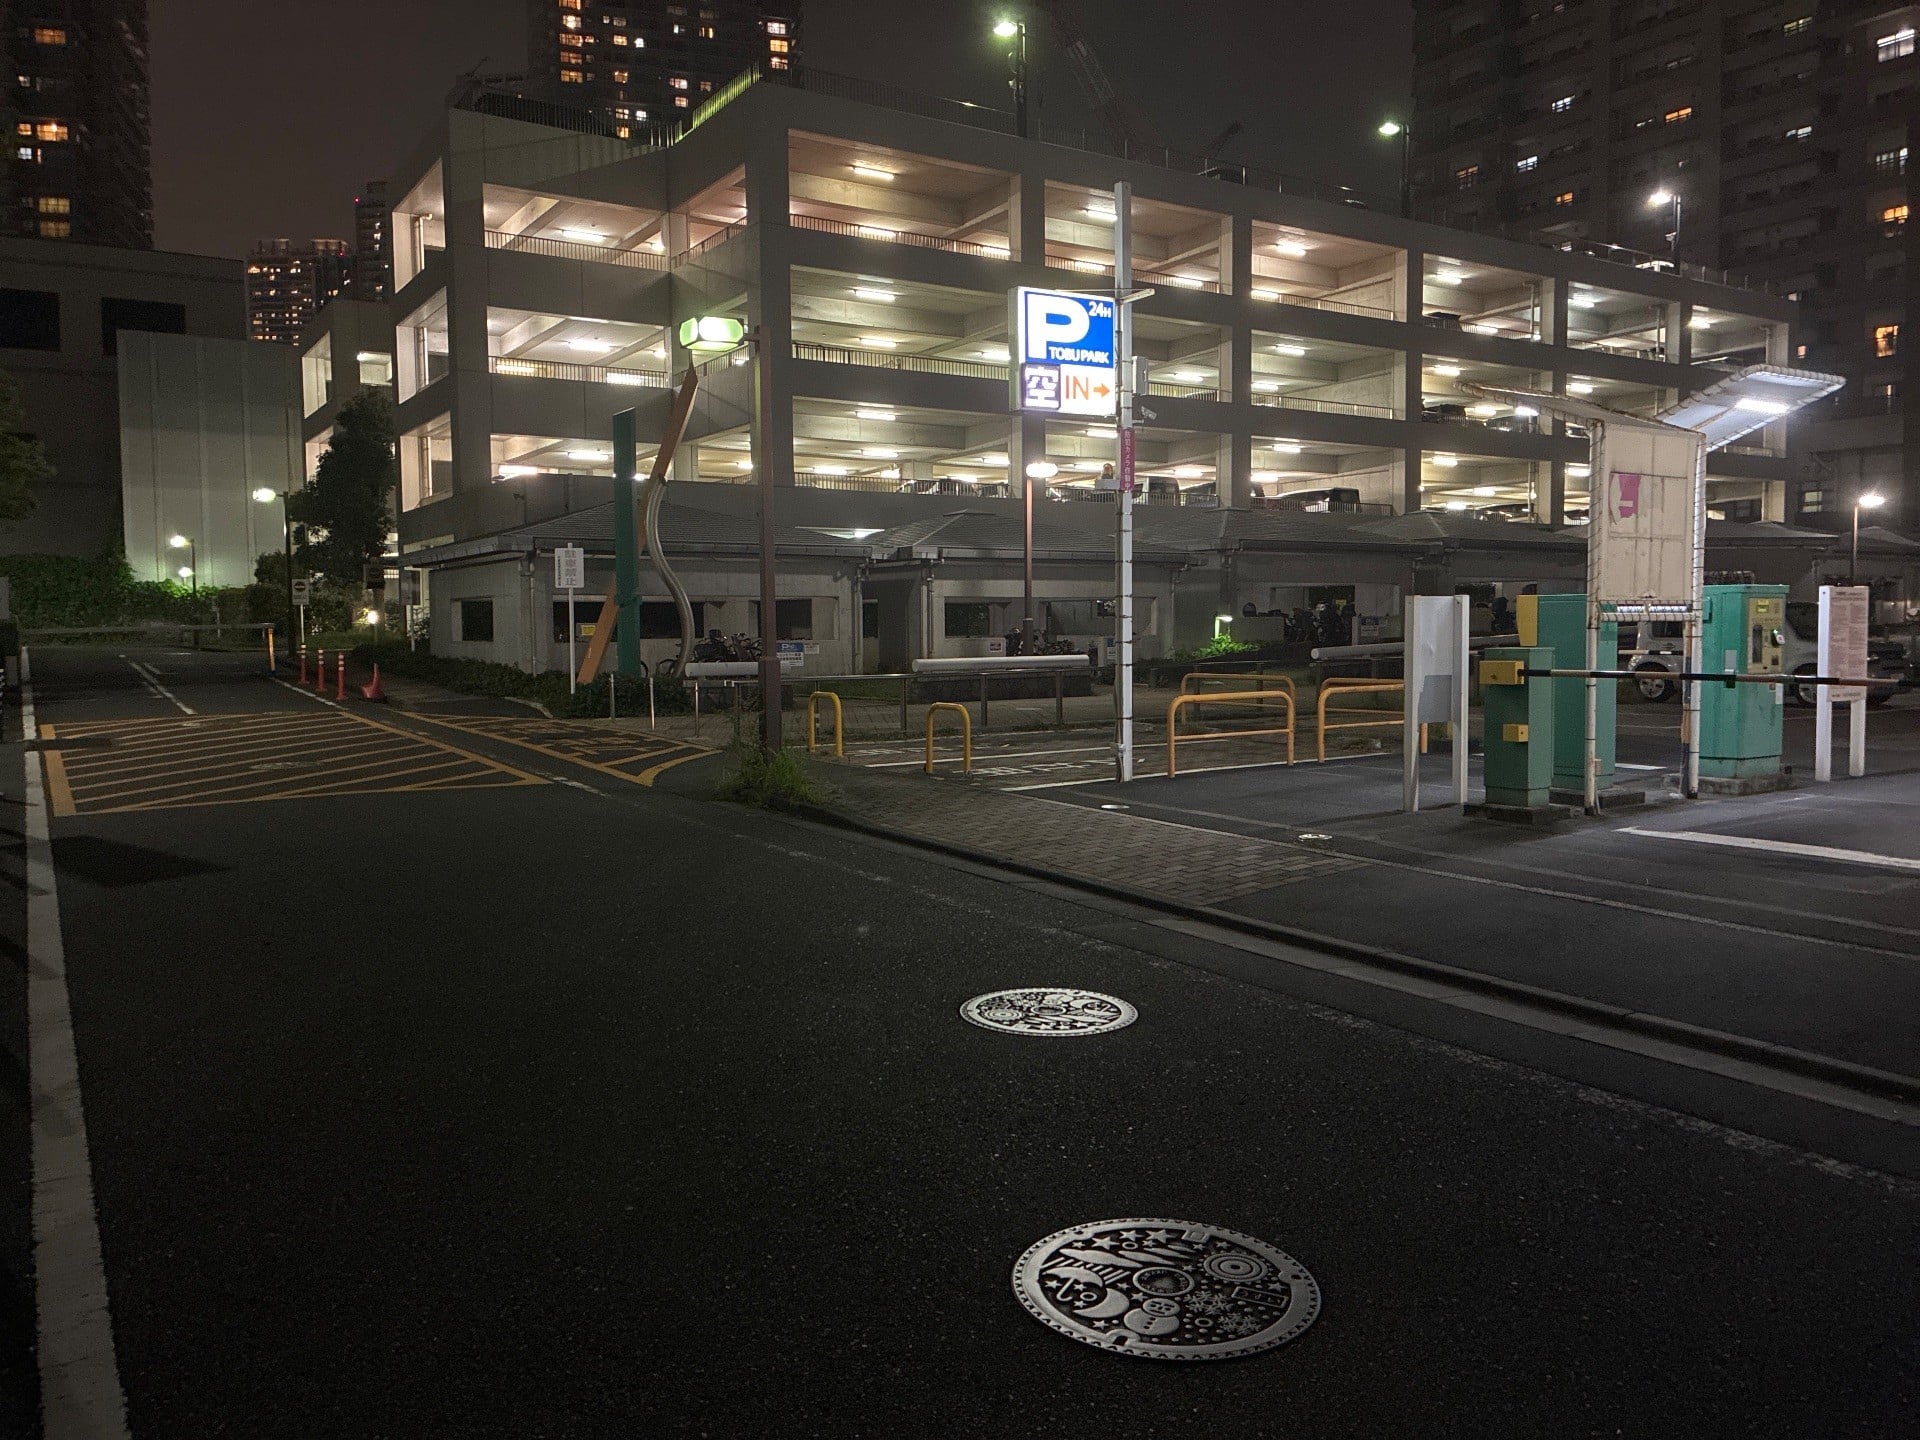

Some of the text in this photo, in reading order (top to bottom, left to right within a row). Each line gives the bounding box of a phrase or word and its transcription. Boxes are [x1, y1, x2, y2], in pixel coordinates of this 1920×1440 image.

[1028, 293, 1090, 359] P
[1024, 367, 1059, 408] 空
[1065, 375, 1090, 401] IN
